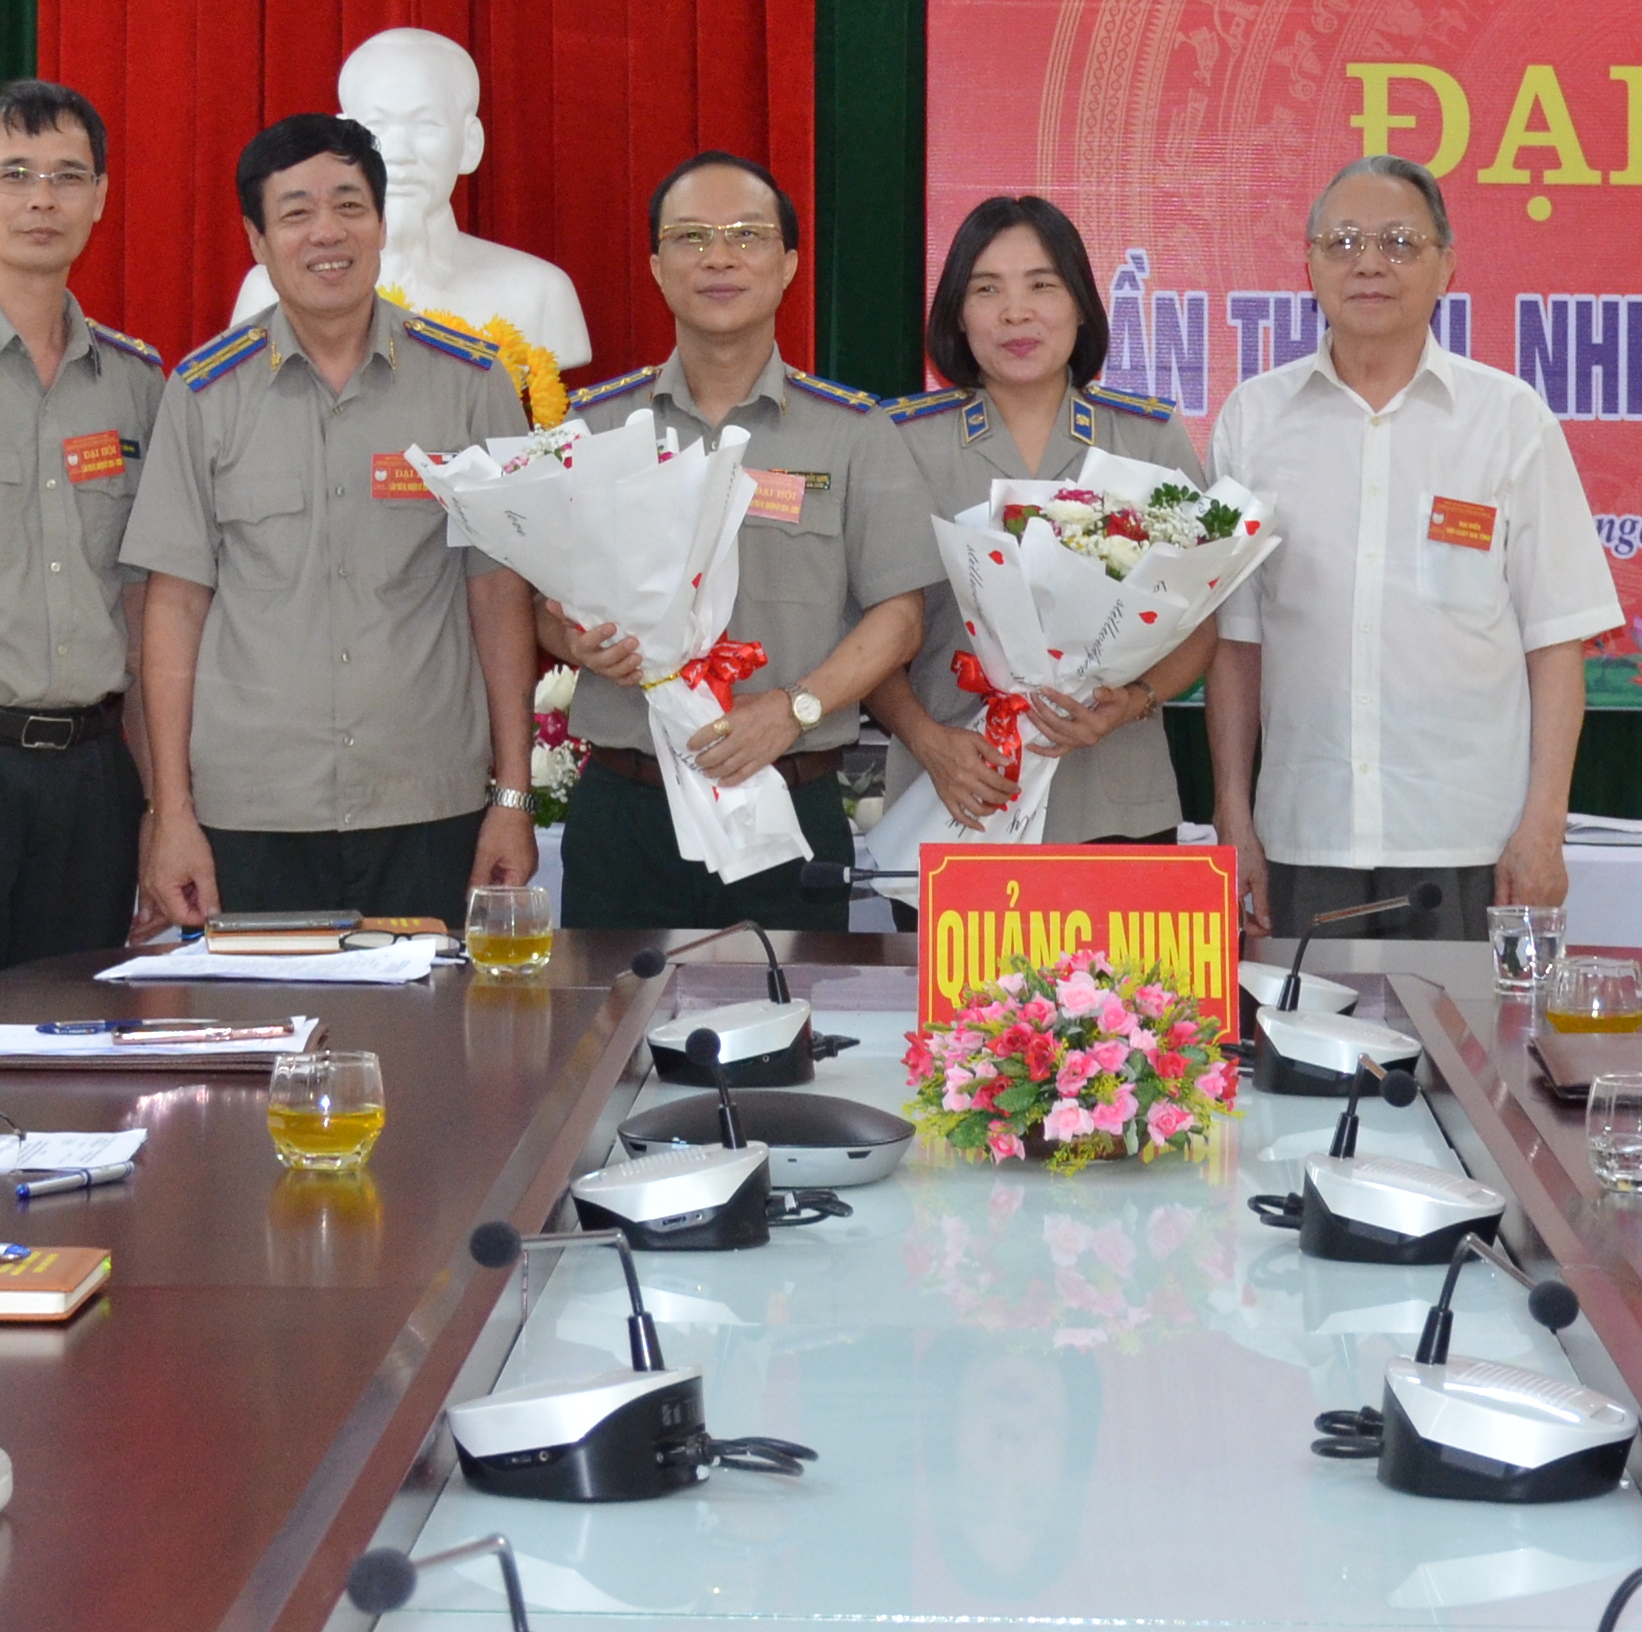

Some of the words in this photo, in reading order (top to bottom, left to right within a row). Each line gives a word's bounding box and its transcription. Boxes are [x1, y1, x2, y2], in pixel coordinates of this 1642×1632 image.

[1101, 247, 1209, 417] ẦN
[1227, 291, 1330, 383] TH
[1109, 911, 1223, 999] NINH
